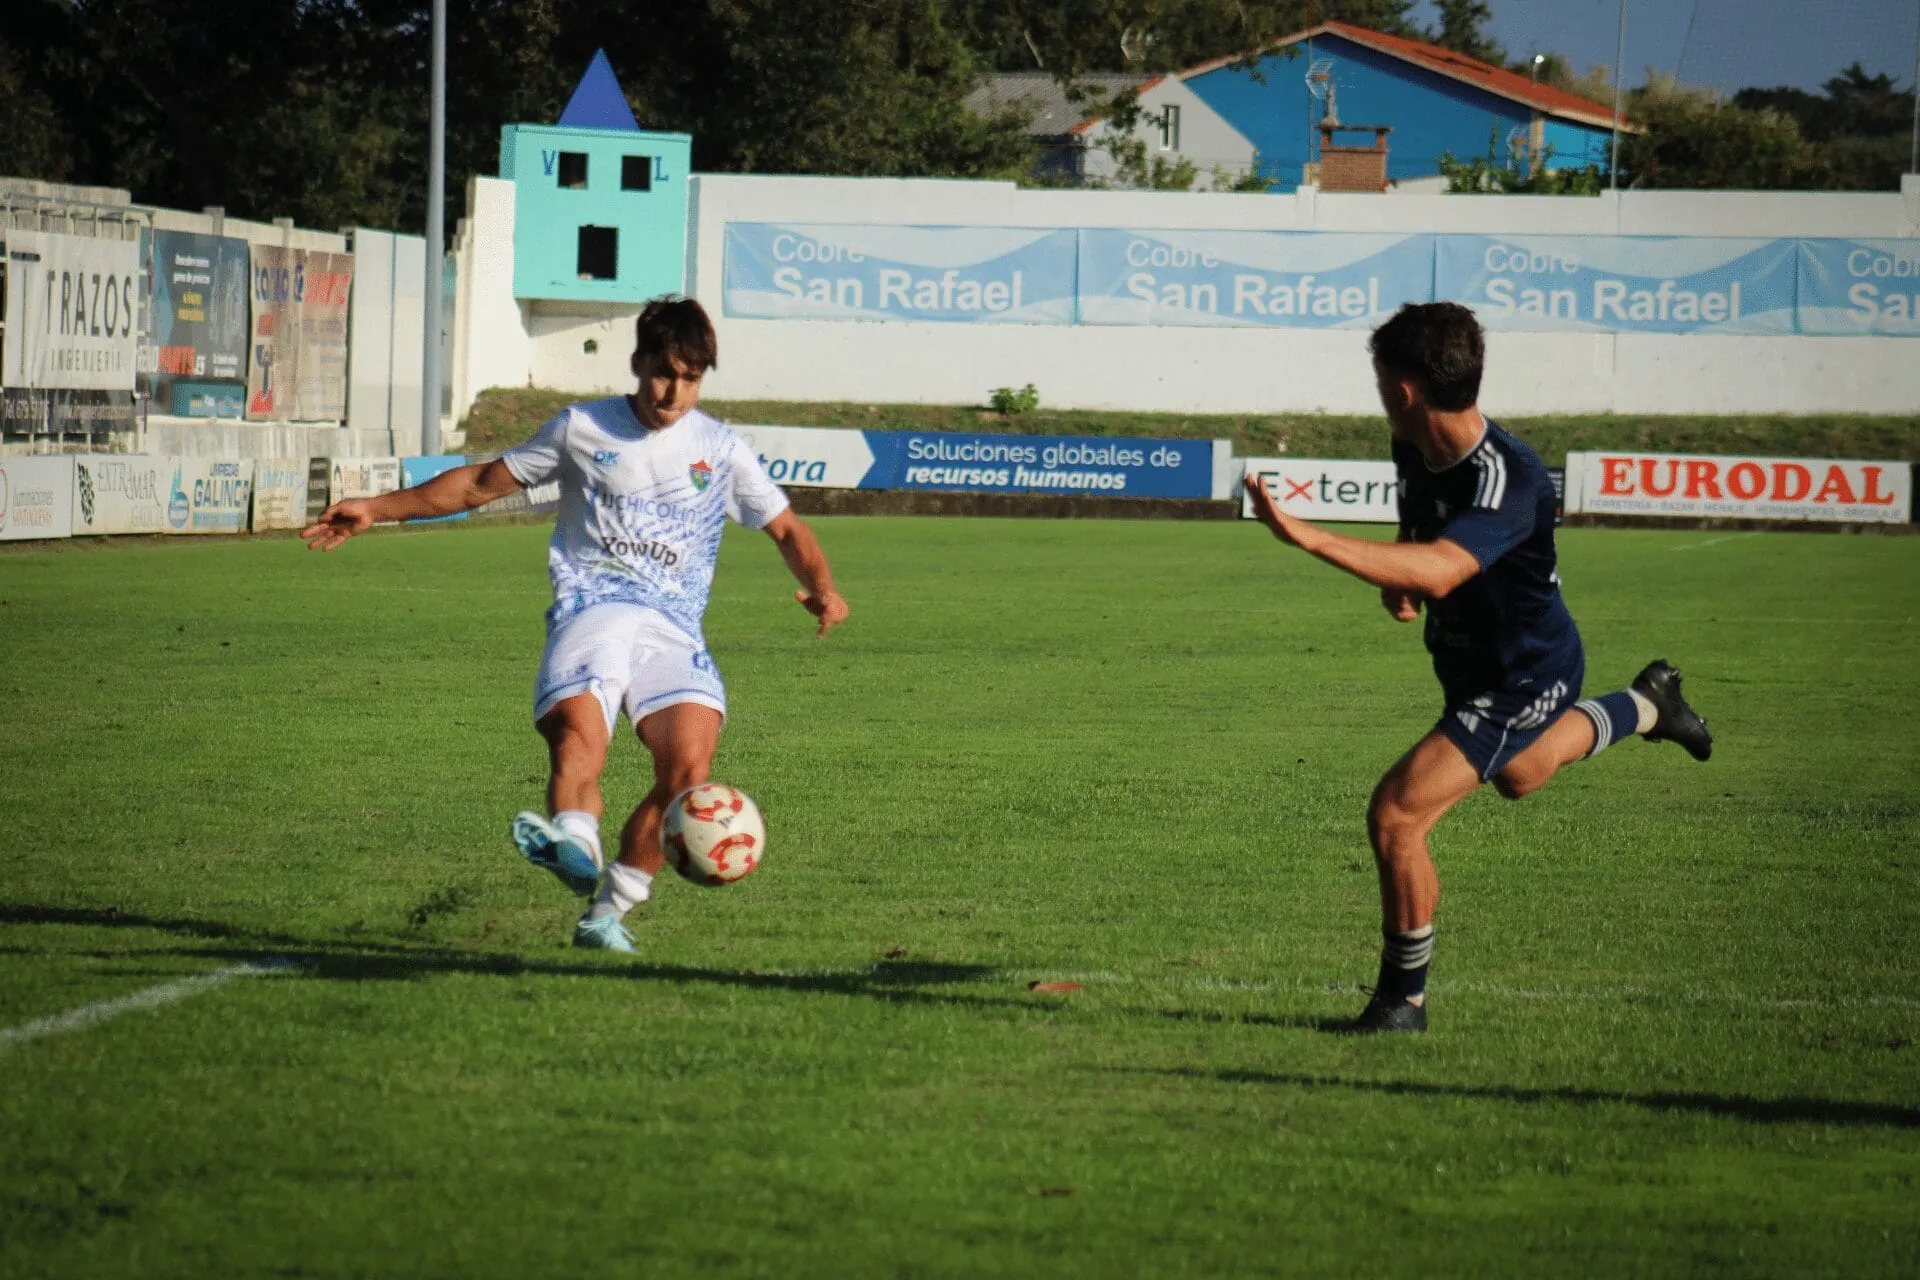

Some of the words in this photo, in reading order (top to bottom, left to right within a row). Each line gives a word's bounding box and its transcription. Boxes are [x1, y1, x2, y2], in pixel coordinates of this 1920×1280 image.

[46, 270, 132, 338] TRAZOS
[772, 267, 864, 310] San
[879, 269, 1023, 312] Rafael
[1127, 272, 1218, 314] San
[1234, 275, 1379, 317] Rafael
[1485, 279, 1577, 320] San
[1594, 280, 1742, 322] Rafael
[1847, 282, 1920, 322] Sa
[907, 437, 1036, 464] Soluciones
[1043, 441, 1144, 468] globales
[1150, 445, 1182, 468] de
[905, 466, 1008, 487] recursos
[1014, 466, 1126, 490] humanos
[1599, 458, 1895, 506] EURODAL
